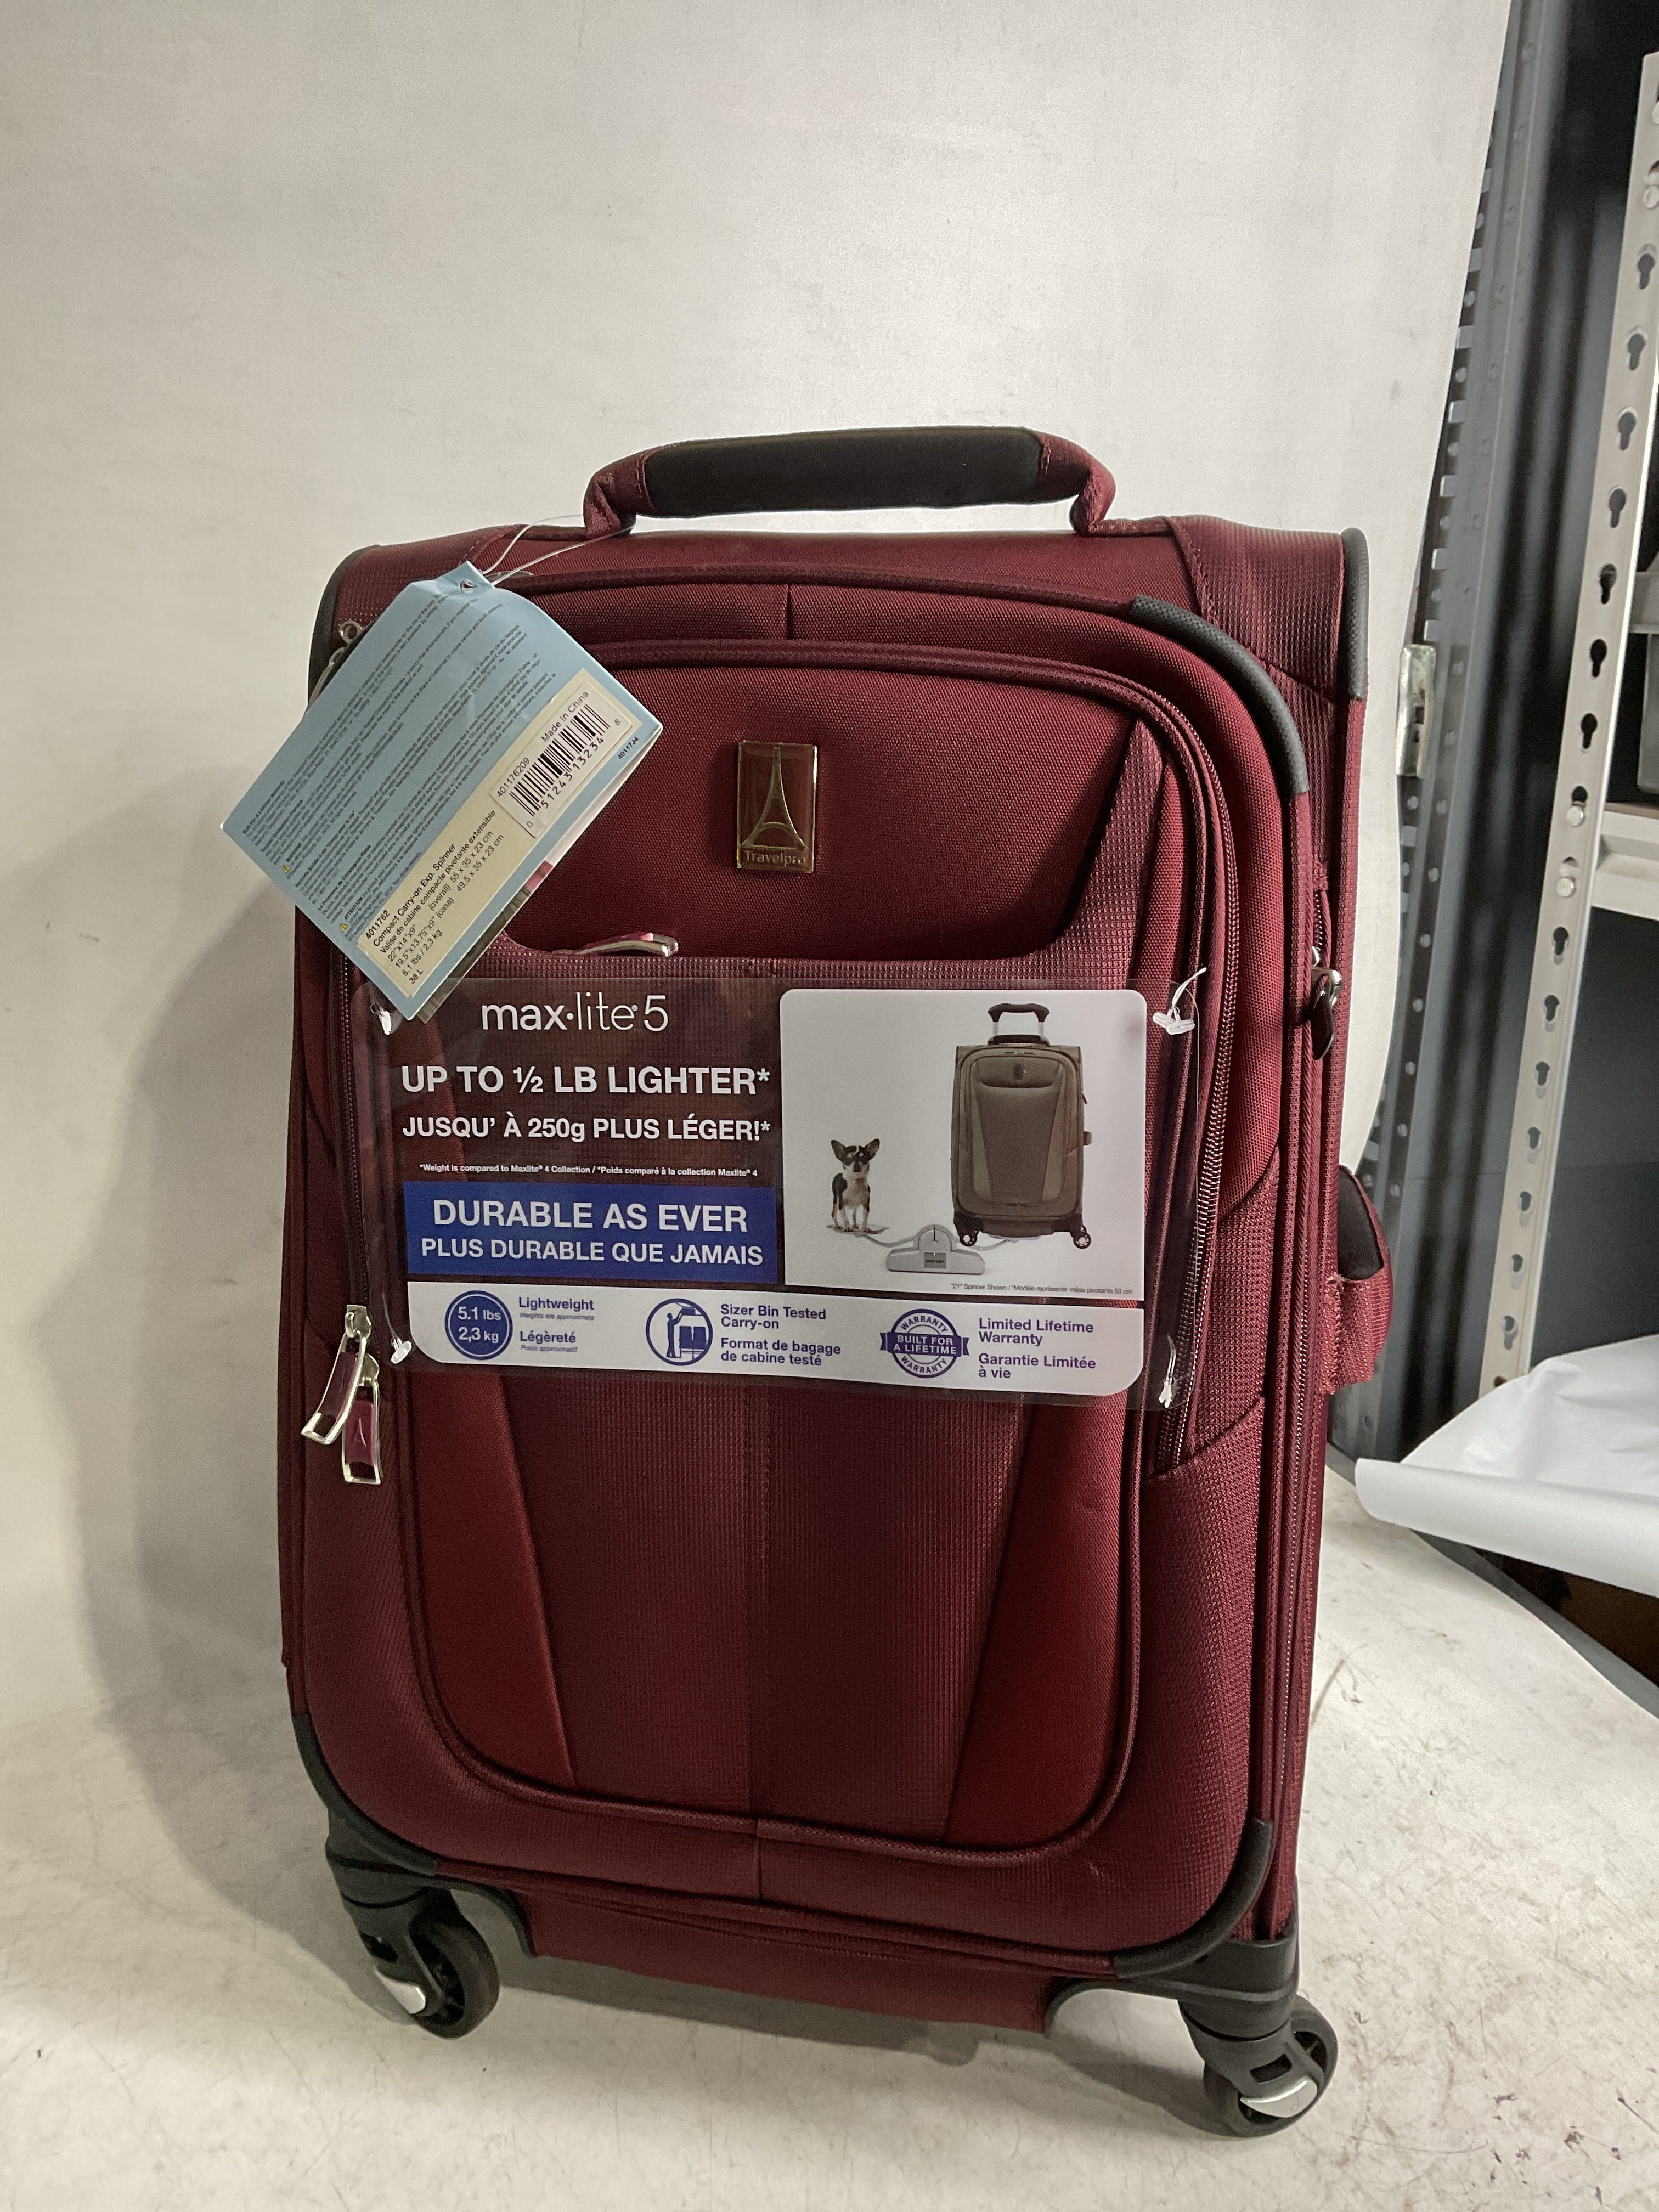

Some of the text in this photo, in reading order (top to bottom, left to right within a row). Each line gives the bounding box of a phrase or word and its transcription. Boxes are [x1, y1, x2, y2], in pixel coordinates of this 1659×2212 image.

[497, 757, 529, 797] 401176209
[541, 721, 561, 742] Made
[568, 692, 588, 712] China
[618, 736, 638, 759] 40117J4
[525, 718, 622, 828] 0 51243 13234 8
[746, 851, 806, 867] Travelpro
[428, 884, 450, 910] (overall)
[449, 872, 459, 882] 55
[462, 857, 471, 867] 35
[473, 842, 483, 853] 23
[483, 831, 493, 842] cm
[436, 897, 454, 918] (case)
[457, 875, 470, 891] 49,5
[472, 860, 482, 871] 35
[484, 845, 494, 856] 23
[494, 834, 504, 846] cm
[380, 811, 495, 952] Valise de cabine compacte pivotante extensible
[373, 844, 455, 946] Compact Carry-on Exp. Spinner
[366, 910, 389, 939] 4011762
[402, 964, 412, 976] 5.1
[410, 954, 421, 965] lbs
[423, 938, 433, 950] 2,3
[431, 929, 442, 939] kg
[409, 973, 418, 984] 38
[644, 995, 668, 1032] 5
[402, 1065, 448, 1092] UP
[456, 1066, 504, 1092] TO
[554, 1067, 596, 1093] LB
[503, 1112, 522, 1138] À
[528, 1118, 586, 1143] 250g
[594, 1118, 659, 1140] PLUS
[460, 1165, 499, 1173] compared
[625, 1167, 659, 1175] comparé
[434, 1199, 747, 1232] DURABLE AS EVER
[421, 1238, 763, 1266] PLUS DURABLE QUE JAMAIS
[518, 1297, 595, 1312] Lightweight
[721, 1304, 826, 1319] Sizer Bin Tested
[458, 1306, 501, 1321] 5.1 lbs
[721, 1316, 779, 1330] Carry-on
[900, 1316, 949, 1333] WARRANTY
[979, 1318, 1093, 1333] Limited Lifetime
[459, 1327, 499, 1343] 2,3 kg
[520, 1330, 576, 1344] Légèreté
[897, 1335, 953, 1346] BUILT FOR
[979, 1331, 1043, 1346] Warranty
[721, 1338, 841, 1356] Format de bagage
[905, 1345, 957, 1355] LIFETIME
[721, 1350, 822, 1365] de cabine testé
[901, 1356, 947, 1373] WARRANTY
[979, 1353, 1096, 1369] Garantie Limitée
[979, 1365, 1011, 1378] à vie
